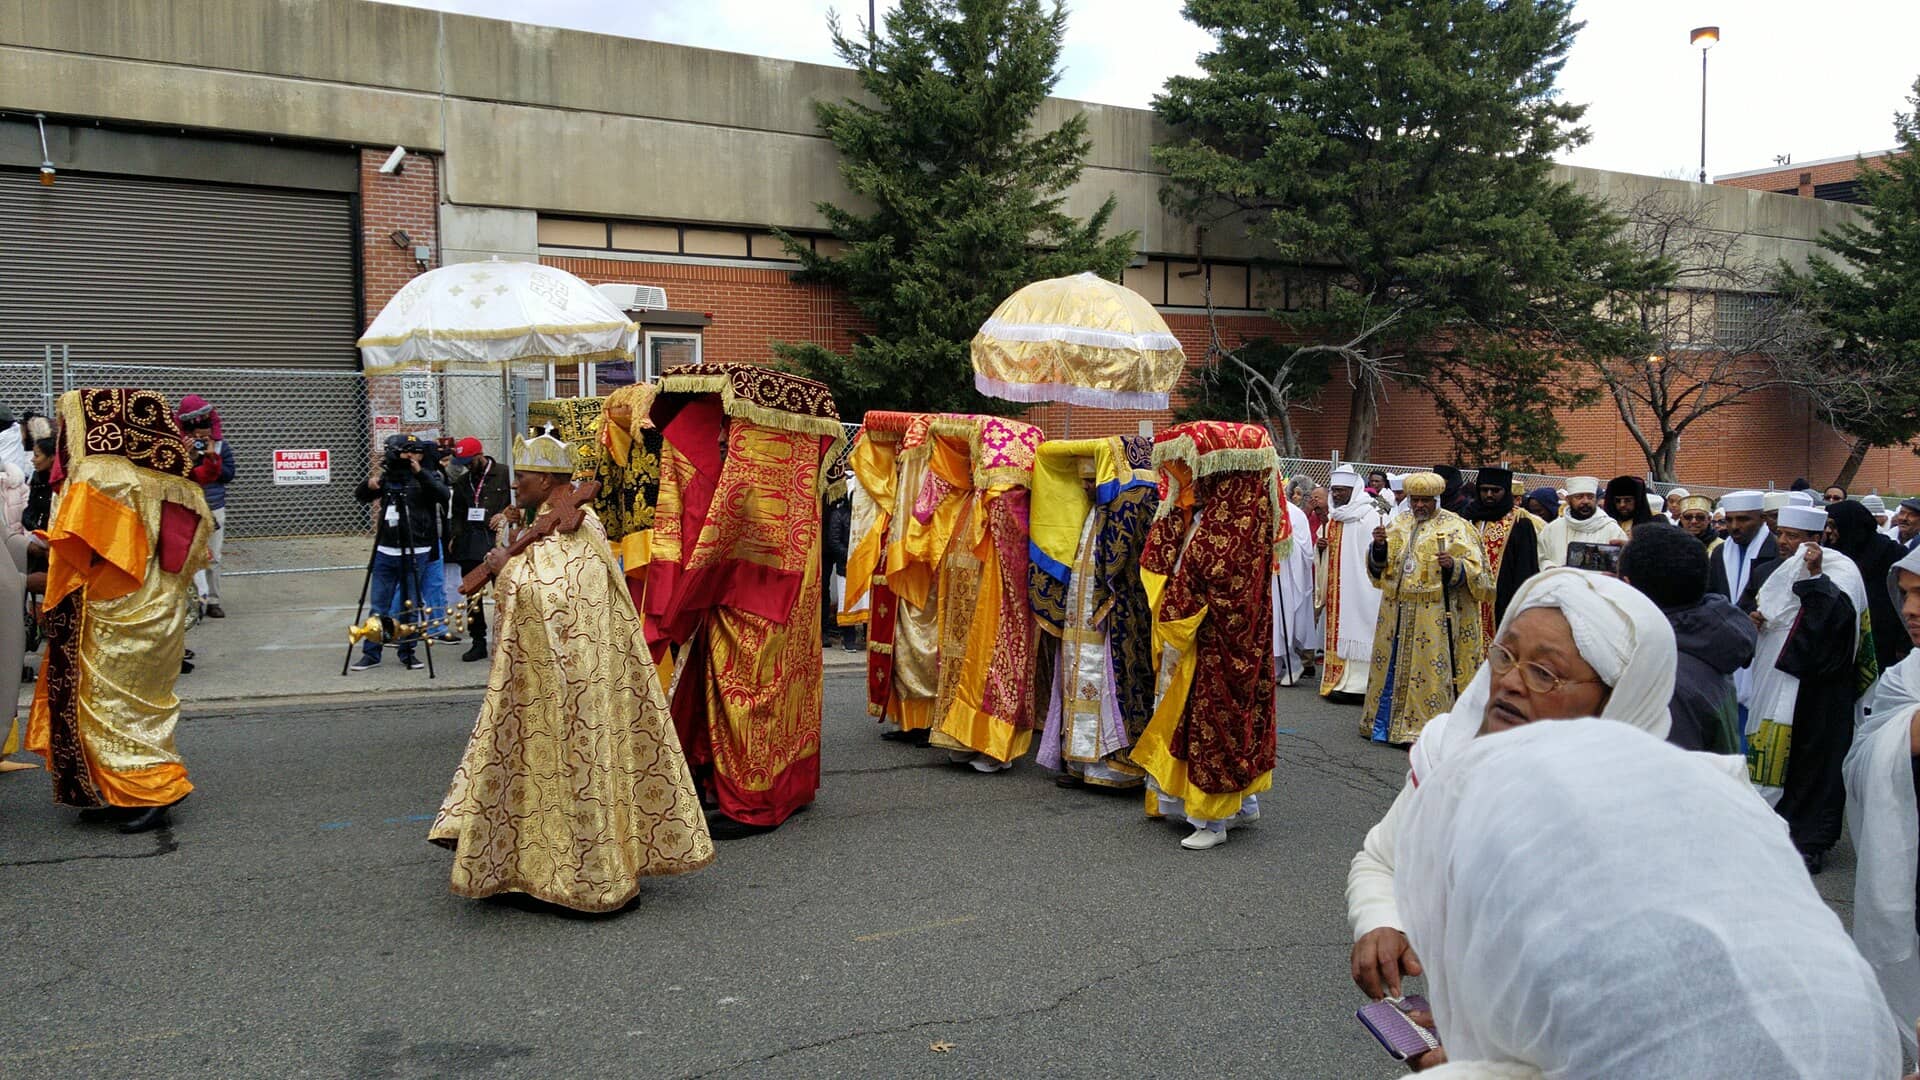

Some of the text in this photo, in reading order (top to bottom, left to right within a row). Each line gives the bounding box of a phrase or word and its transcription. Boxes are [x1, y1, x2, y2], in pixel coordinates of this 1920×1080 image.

[415, 401, 427, 418] 5
[281, 452, 321, 460] PRIVATE
[277, 460, 326, 469] PROPERTY
